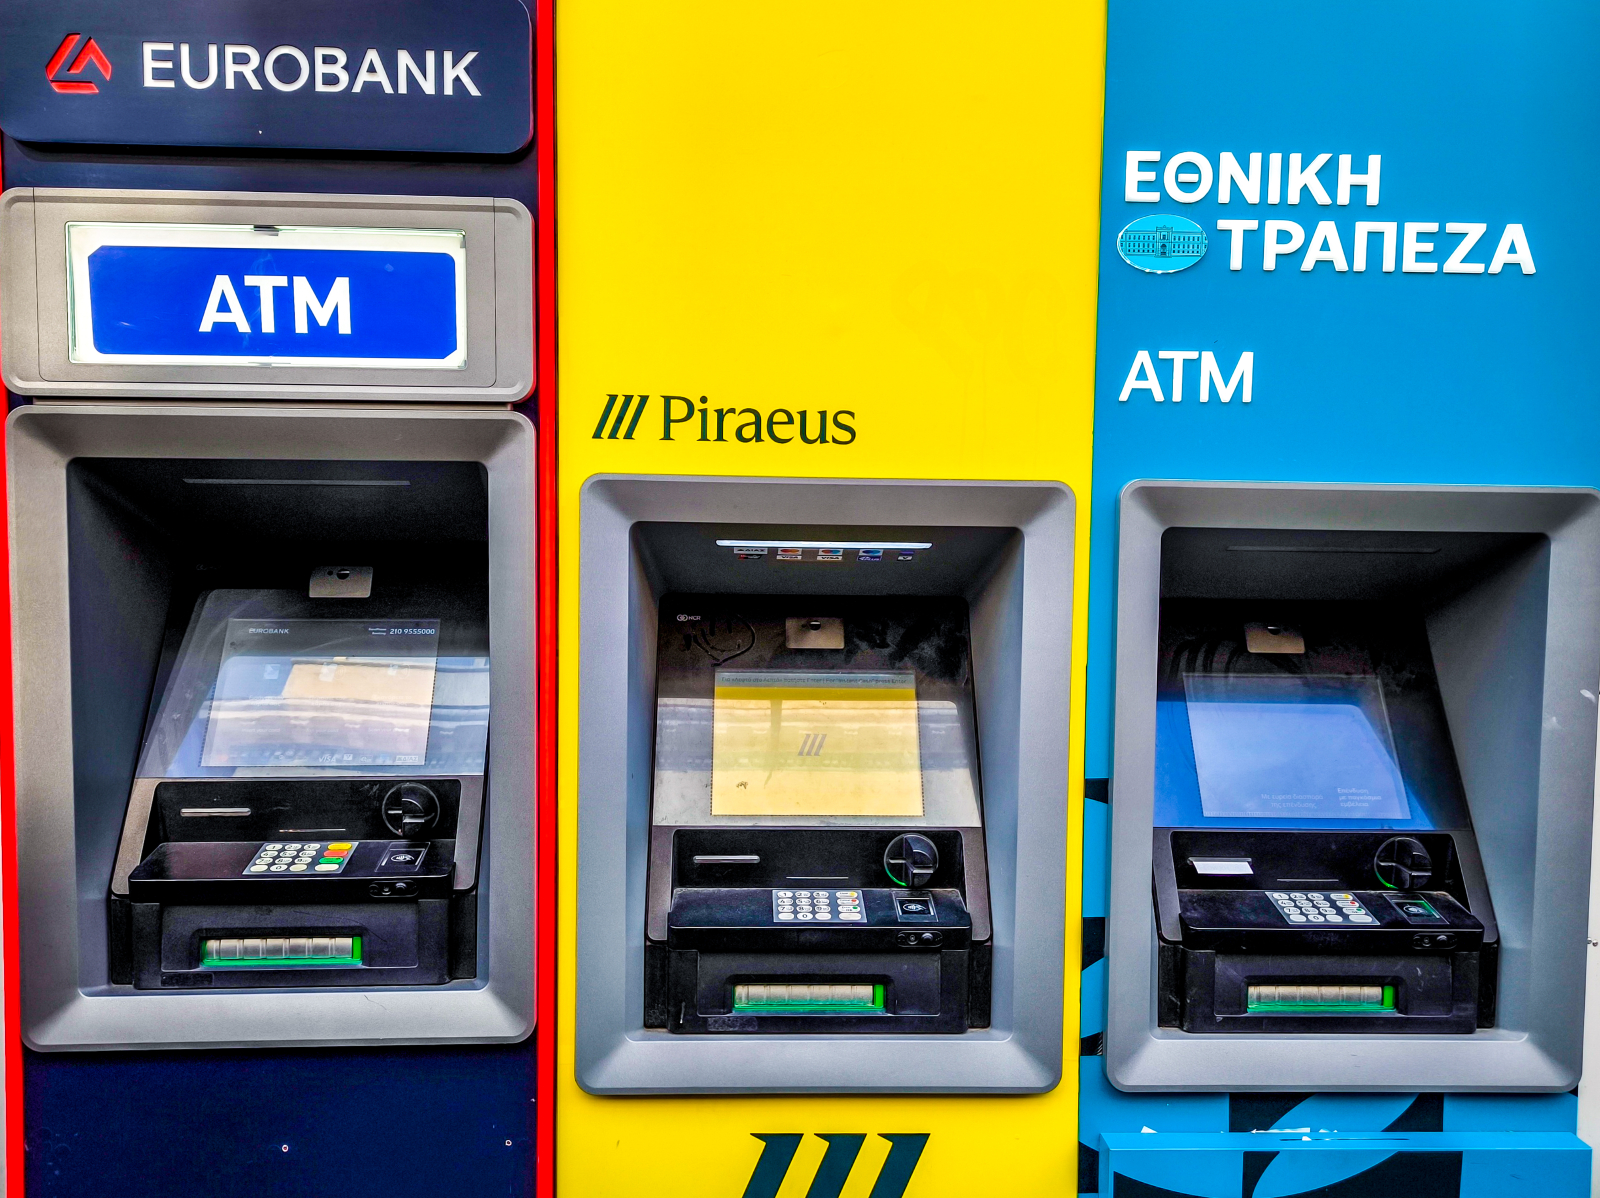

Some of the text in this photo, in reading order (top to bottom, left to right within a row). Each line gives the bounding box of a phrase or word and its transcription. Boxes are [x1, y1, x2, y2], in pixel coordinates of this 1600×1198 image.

[142, 42, 482, 97] EUROBANK
[1125, 150, 1382, 206] ΕΘΝΙΚΗ
[1216, 219, 1537, 275] ΤΡΑΠΕΖΑ
[198, 274, 352, 335] ATM
[1118, 350, 1255, 404] ATM
[659, 395, 857, 445] Piraeus
[318, 754, 337, 763] VISA
